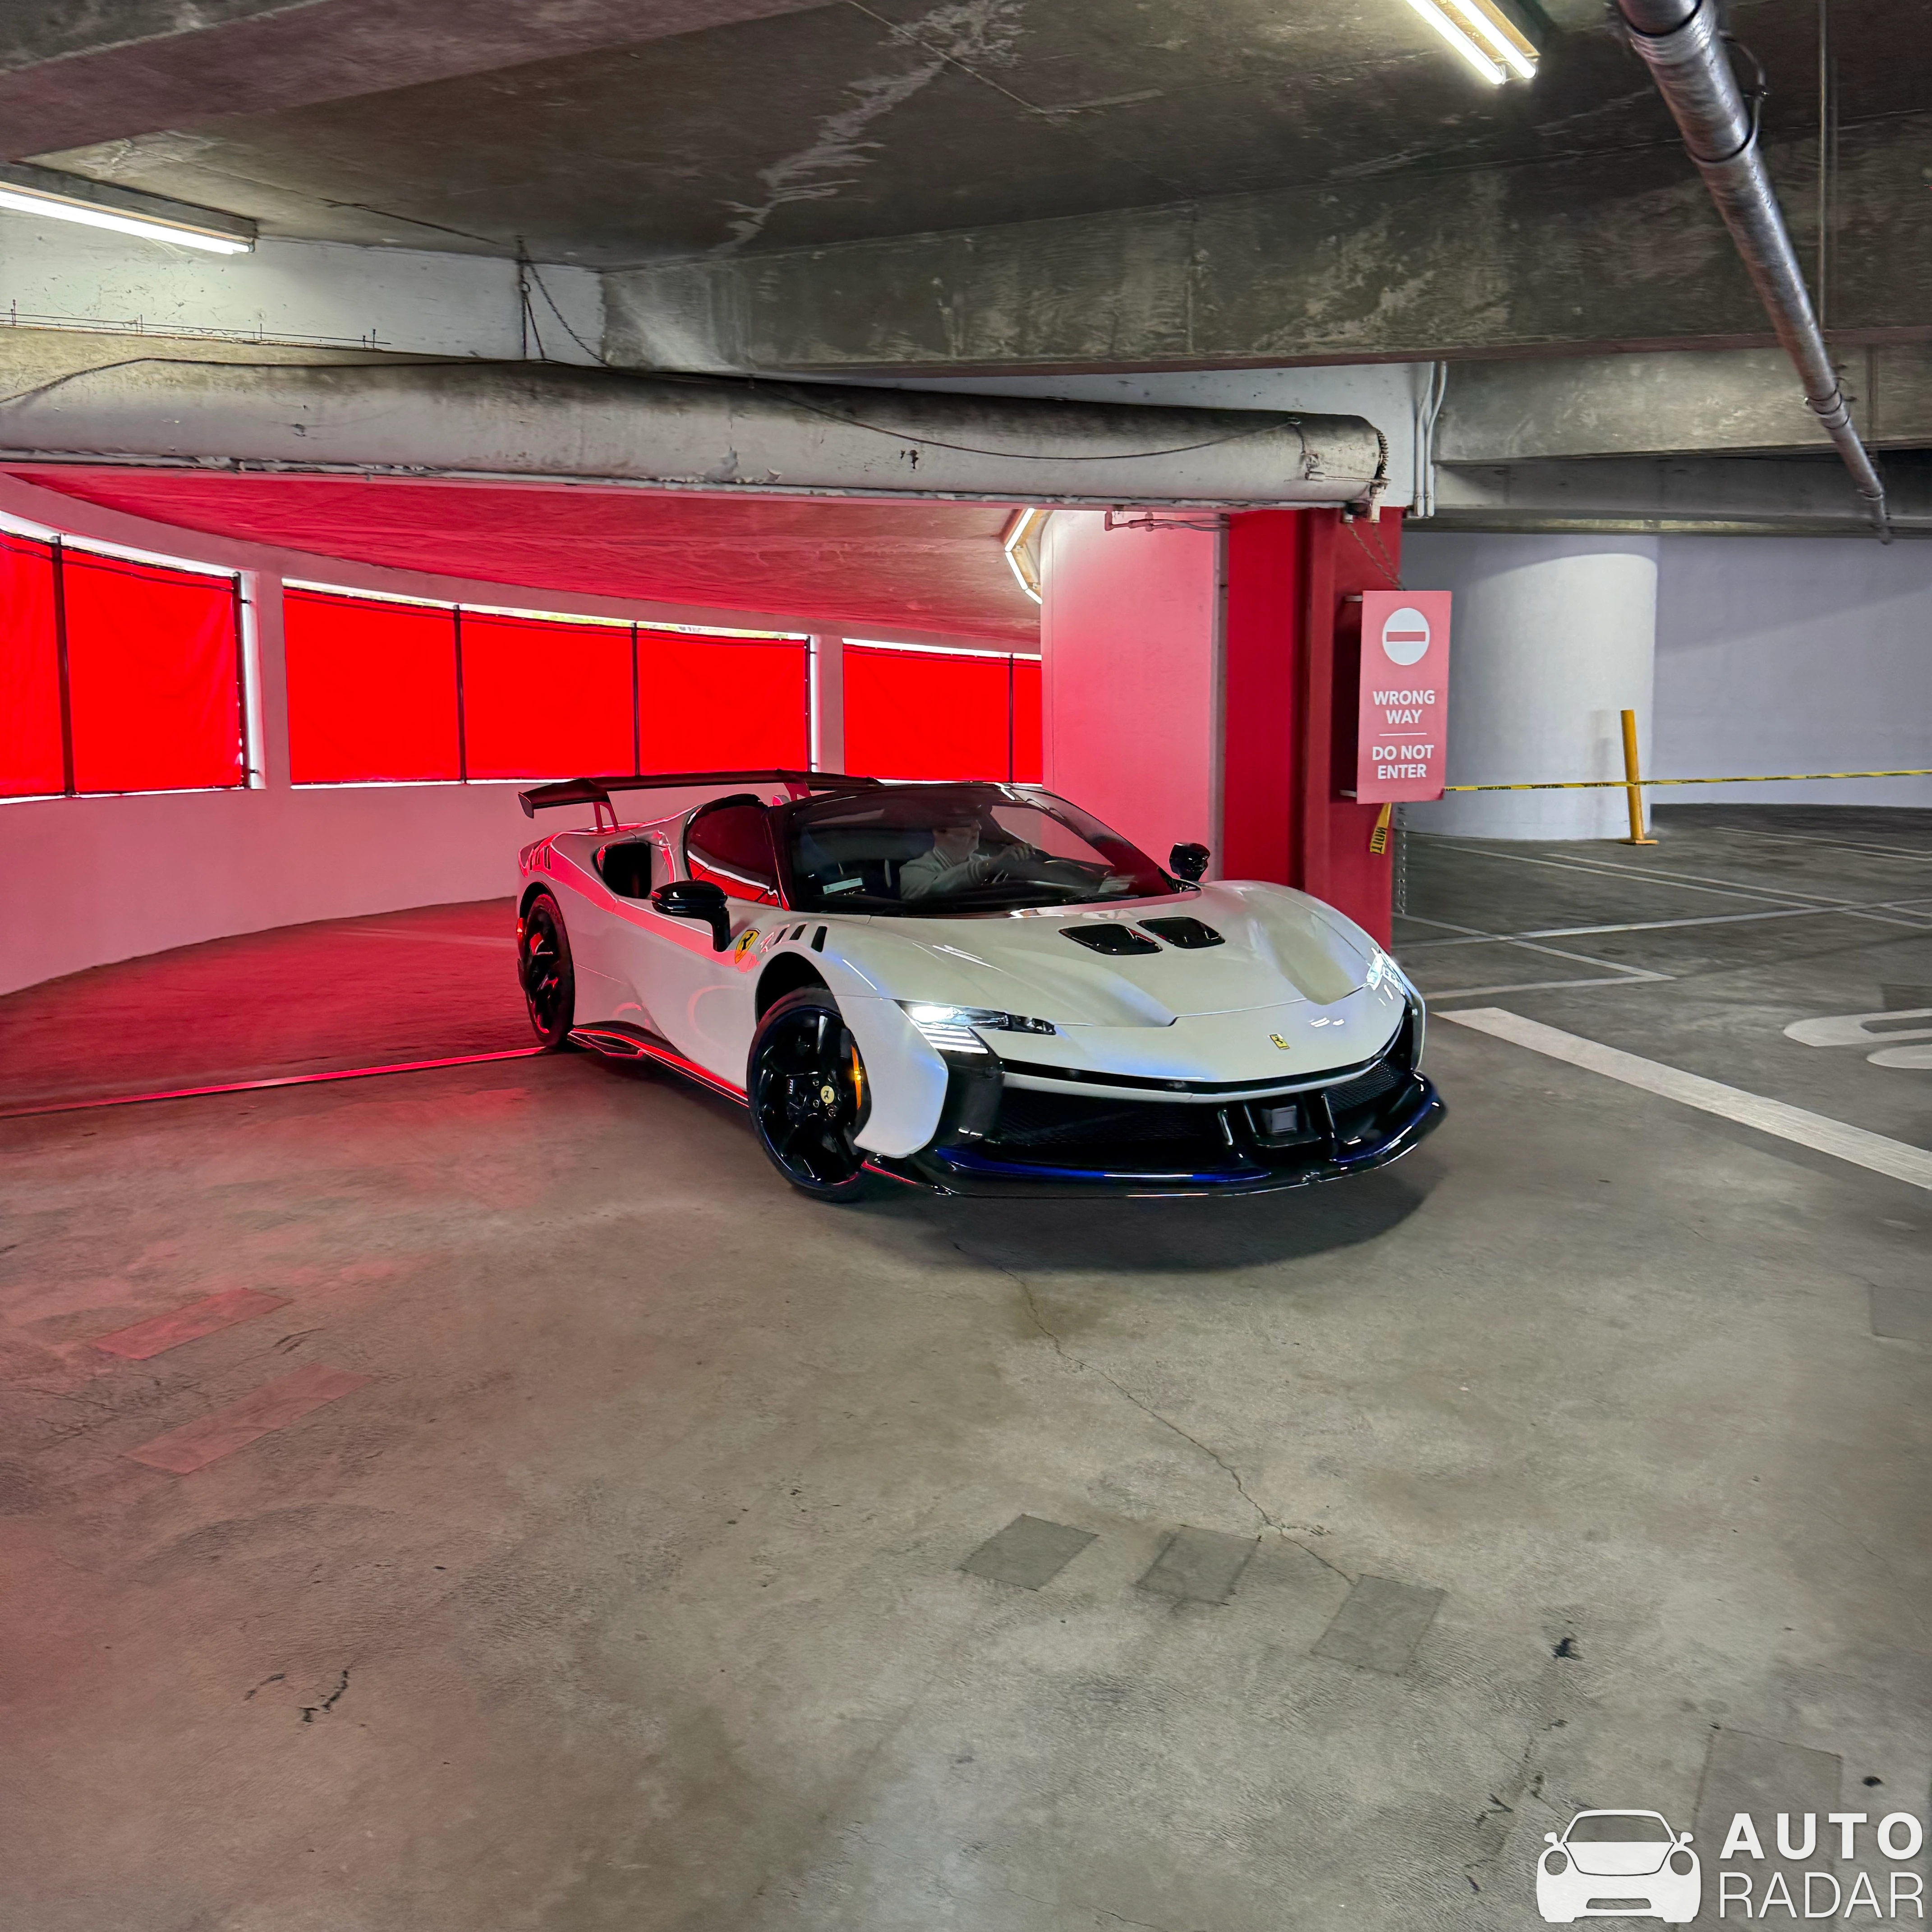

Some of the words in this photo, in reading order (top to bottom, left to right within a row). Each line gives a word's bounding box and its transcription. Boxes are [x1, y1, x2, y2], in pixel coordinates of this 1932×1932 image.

[1372, 690, 1435, 705] WRONG
[1386, 709, 1422, 724] WAY
[1372, 745, 1397, 760] DO
[1401, 745, 1435, 759] NOT
[1378, 764, 1426, 779] ENTER
